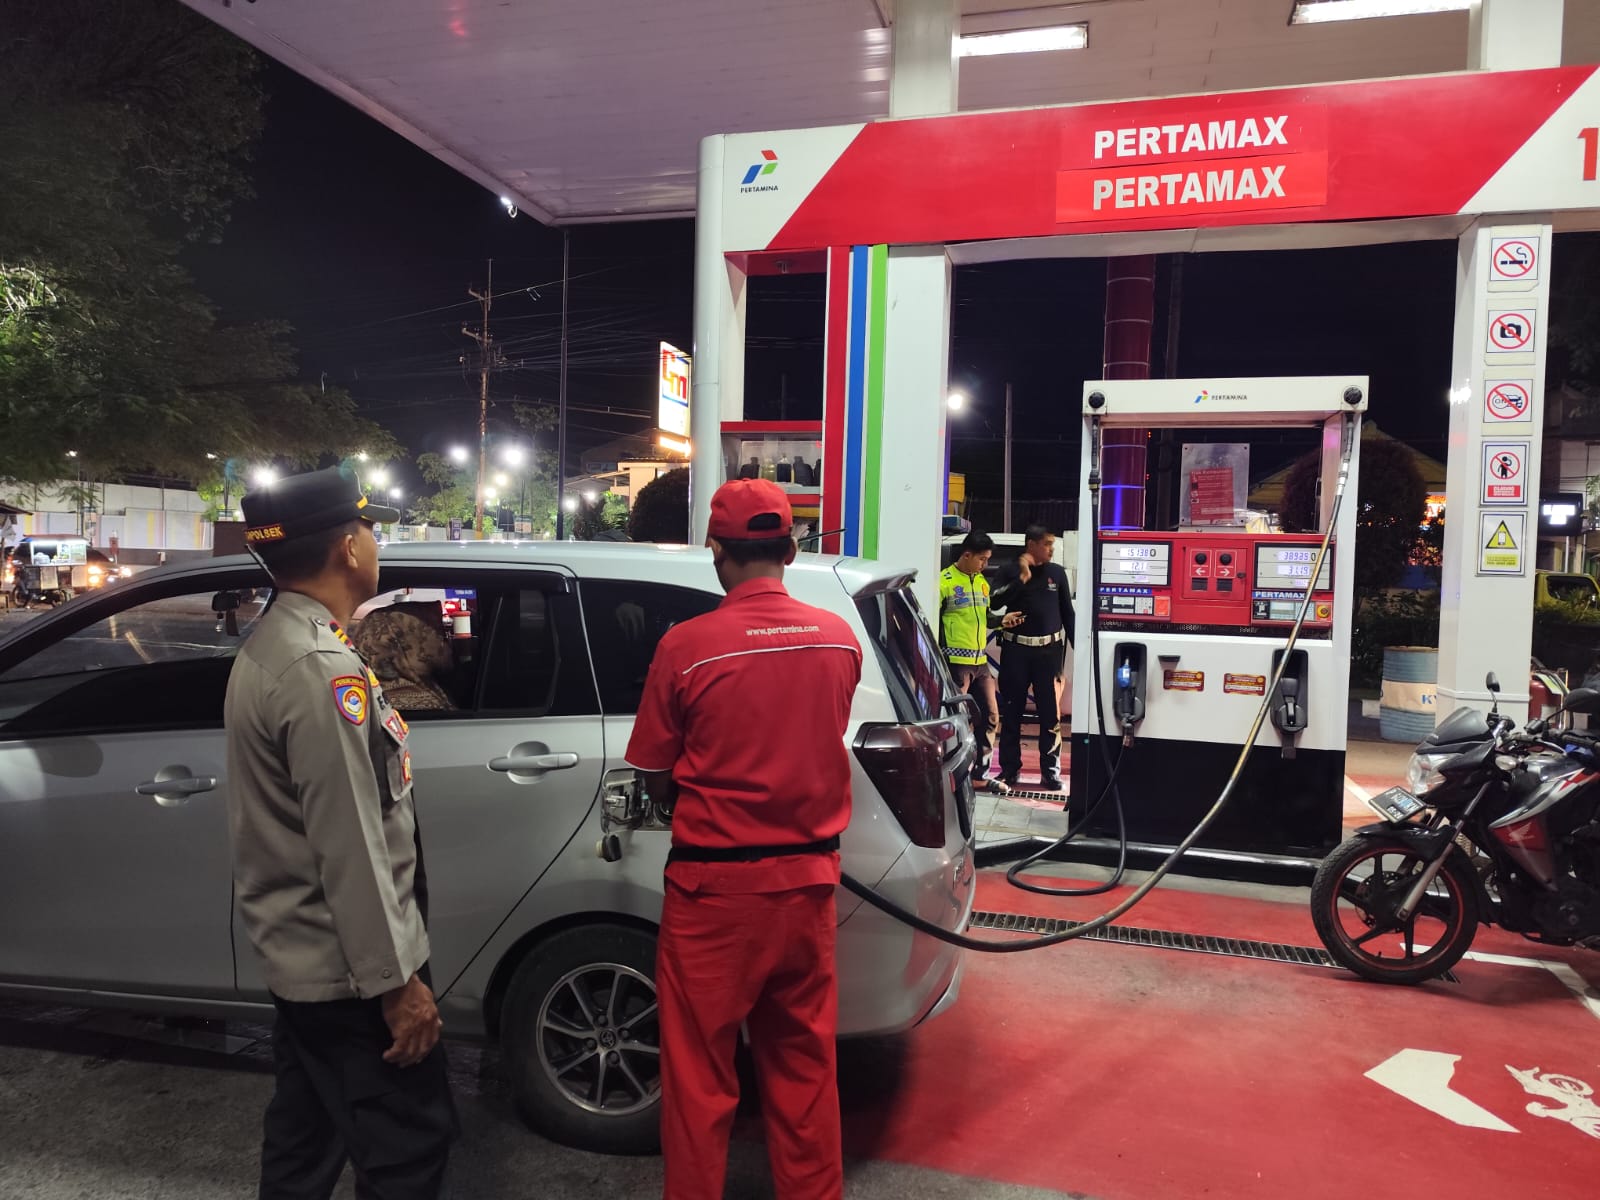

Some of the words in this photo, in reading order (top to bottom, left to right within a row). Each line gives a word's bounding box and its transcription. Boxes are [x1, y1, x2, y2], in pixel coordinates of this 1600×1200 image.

[1094, 115, 1289, 160] PERTAMAX
[740, 184, 779, 193] PERTAMINA
[1093, 165, 1287, 211] PERTAMAX
[1099, 586, 1148, 595] PERTAMAX
[1254, 590, 1306, 599] PERTAMAX
[745, 625, 820, 637] www.pertamina.com
